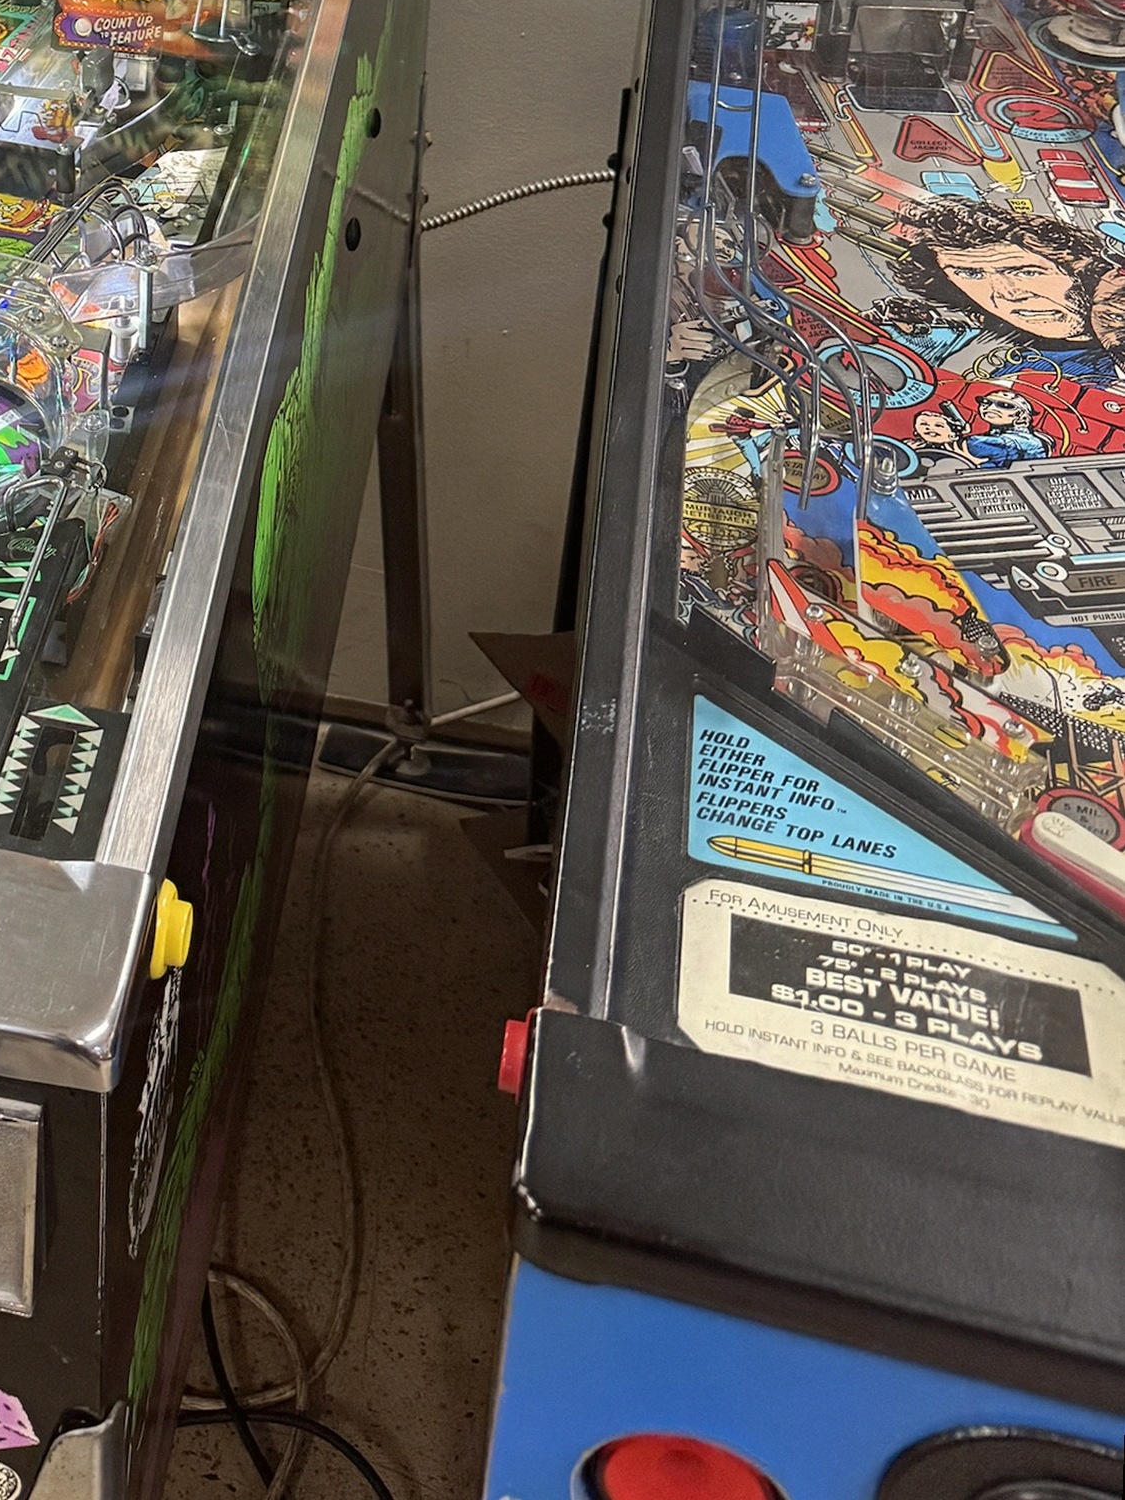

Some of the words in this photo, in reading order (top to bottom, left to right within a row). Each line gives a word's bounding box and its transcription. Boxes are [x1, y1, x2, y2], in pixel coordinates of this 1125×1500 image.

[93, 16, 134, 32] COUNT
[136, 15, 154, 28] UP
[109, 25, 163, 47] FEATURE
[982, 503, 1028, 514] MILLION
[1078, 575, 1118, 589] FIRE
[1071, 615, 1089, 623] HOT
[699, 728, 751, 749] HOLD
[698, 743, 767, 768] EITHER
[697, 757, 775, 785] FLIPPER
[781, 774, 821, 794] FOR
[696, 791, 789, 821] FLIPPERS
[697, 772, 784, 800] INSTANT
[788, 790, 836, 812] INFO
[696, 806, 779, 835] CHANGE
[785, 824, 825, 844] TOP
[830, 834, 899, 860] LANES
[822, 879, 861, 893] PROUDLY
[864, 888, 890, 899] MADE
[893, 894, 903, 902] IN
[907, 897, 924, 906] THE
[709, 889, 744, 906] FOR
[747, 896, 852, 929] AMUSEMENT
[856, 918, 904, 939] ONLY
[905, 956, 972, 980] PLAY
[805, 966, 882, 999] BEST
[888, 983, 1001, 1031] VALUE!
[880, 967, 898, 982] 2
[902, 972, 988, 1004] PLAYS
[770, 983, 866, 1018] $1.00
[894, 1010, 918, 1030] 3
[926, 1017, 1044, 1062] PLAYS
[704, 1019, 745, 1036] HOLD
[748, 1027, 809, 1051] INSTANT
[812, 1041, 846, 1058] INFO
[850, 1050, 862, 1061] &
[866, 1051, 894, 1069] SEE
[897, 1060, 985, 1093] BACKGLASS
[987, 1084, 1019, 1100] FOR
[810, 1019, 824, 1035] 3
[832, 1024, 898, 1051] BALLS
[904, 1039, 947, 1063] PER
[952, 1052, 1018, 1083] GAME
[838, 1062, 904, 1087] Maximum
